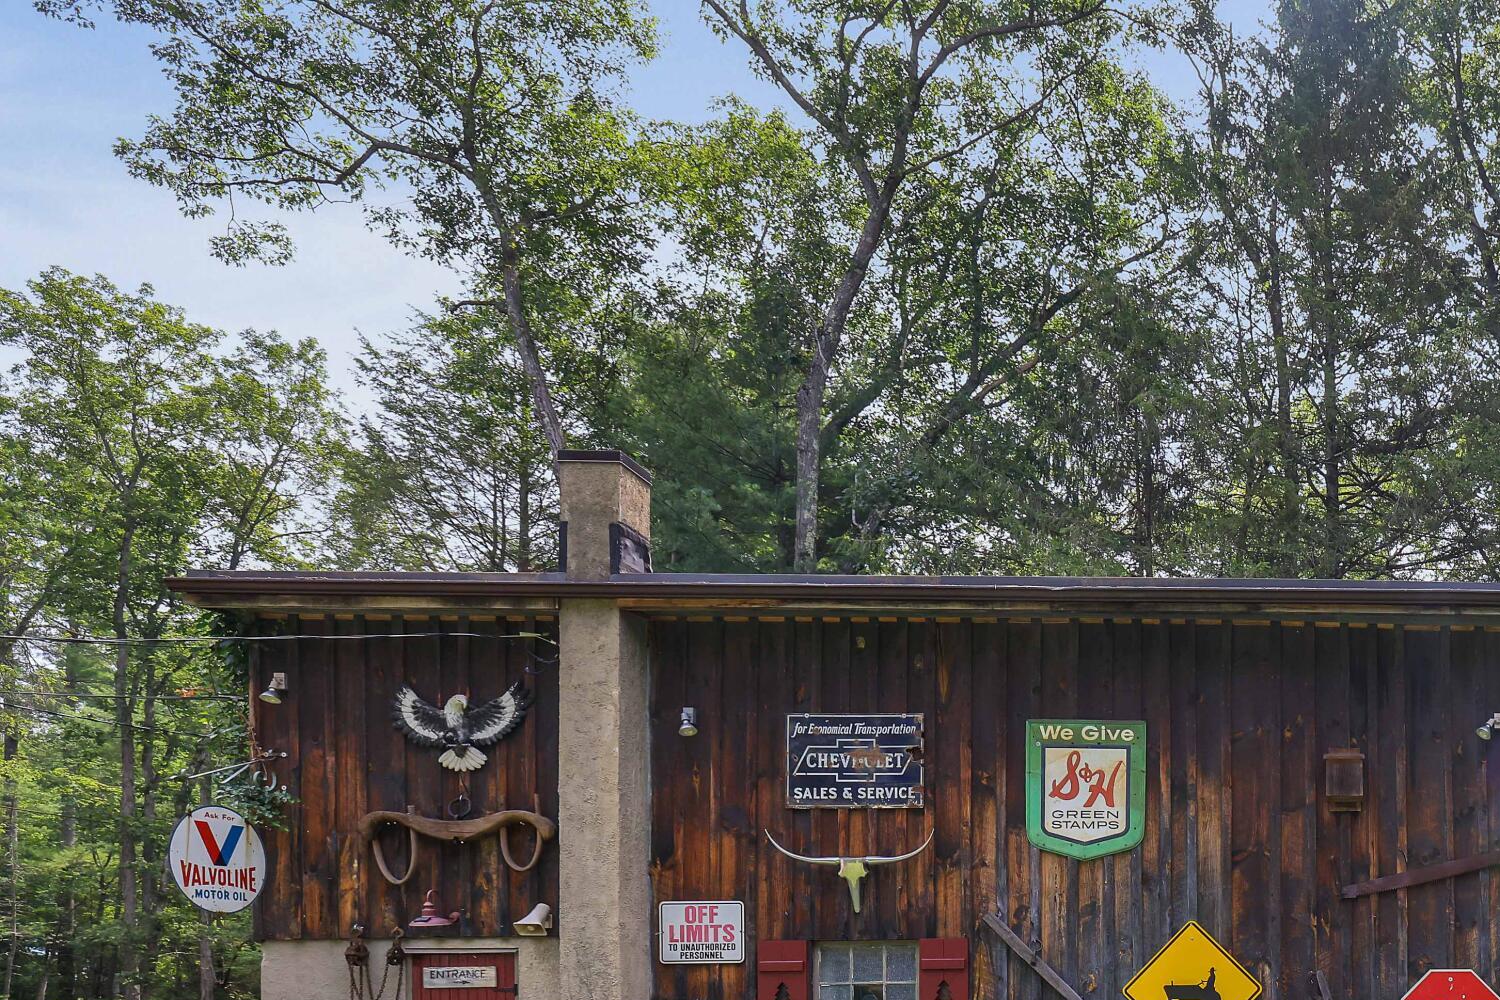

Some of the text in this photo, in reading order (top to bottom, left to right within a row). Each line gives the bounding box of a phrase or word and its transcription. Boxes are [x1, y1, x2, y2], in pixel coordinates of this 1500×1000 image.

[791, 722, 806, 738] for
[854, 722, 916, 737] Transportation
[1040, 725, 1135, 741] We Give
[1048, 750, 1123, 808] S&H
[793, 786, 916, 800] SALES & SERVICE
[204, 811, 235, 822] Ask For
[1051, 809, 1119, 819] GREEN
[1051, 820, 1119, 830] STAMPS
[180, 859, 257, 893] VALVOLINE
[194, 888, 248, 902] MOTOR OIL
[684, 905, 719, 924] OFF
[668, 924, 736, 943] LIMITS
[668, 943, 736, 951] TO UNAUTHORIZED
[680, 951, 724, 960] PERSONNEL
[429, 969, 487, 980] ENTRANCE
